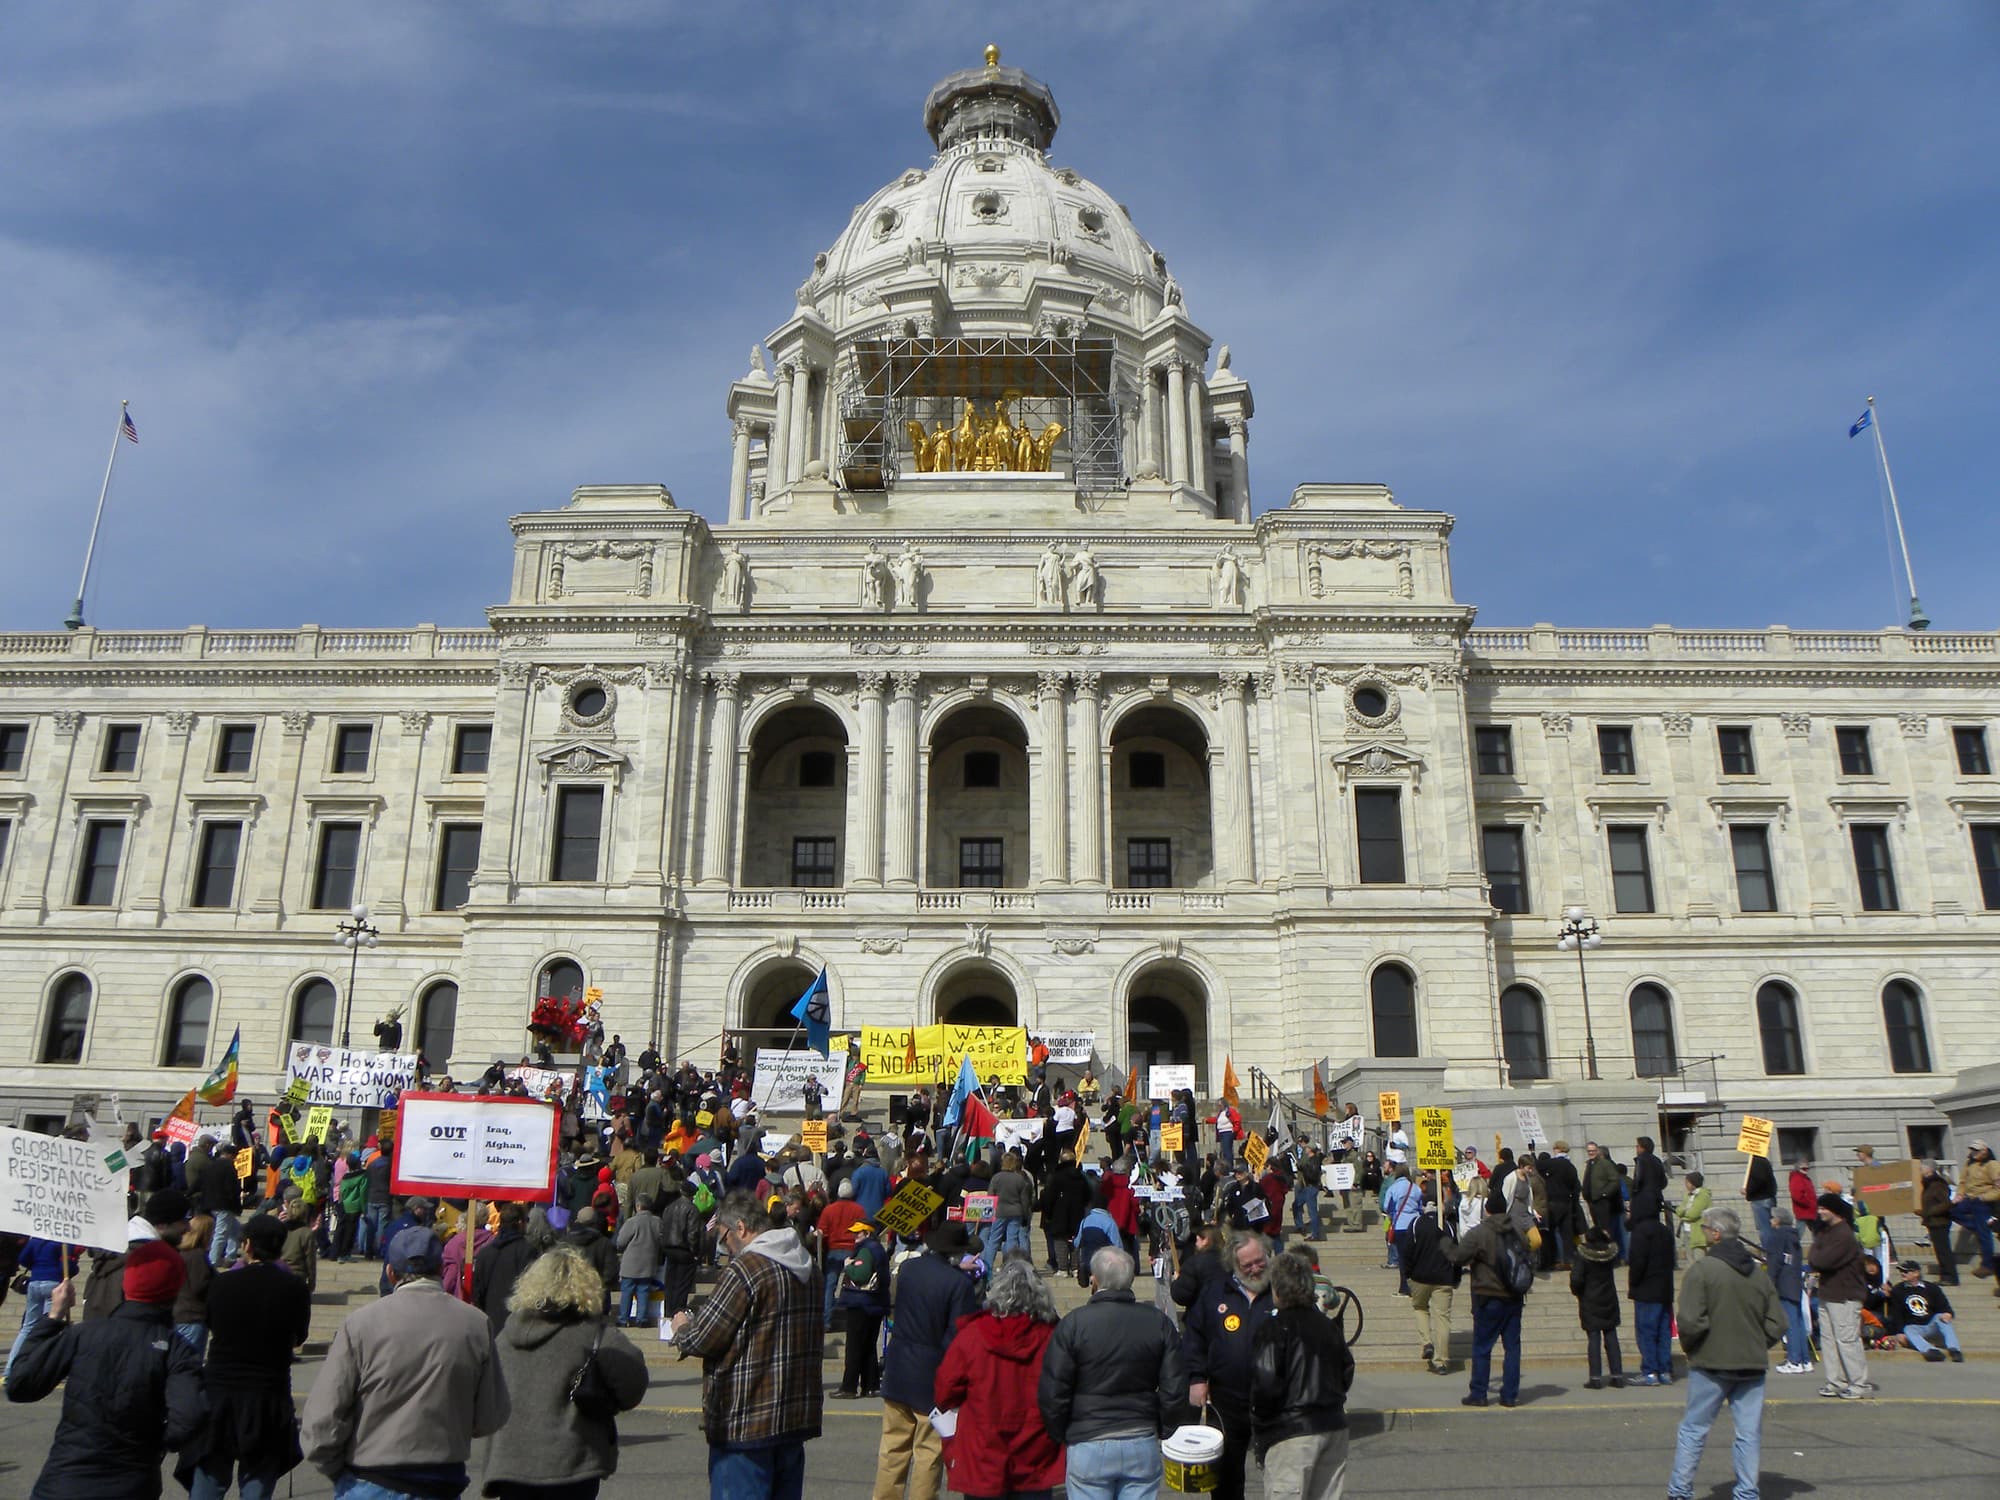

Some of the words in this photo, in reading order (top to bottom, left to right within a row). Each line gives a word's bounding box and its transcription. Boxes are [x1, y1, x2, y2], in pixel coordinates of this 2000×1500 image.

[870, 1032, 910, 1048] HAD
[954, 1027, 1009, 1040] W.A.R.
[948, 1040, 1015, 1055] Wasted
[1048, 1038, 1068, 1047] MORE
[340, 1052, 385, 1069] How's
[391, 1057, 415, 1070] the
[947, 1056, 1019, 1069] Aerican
[292, 1065, 334, 1083] WAR
[339, 1070, 414, 1090] ECONOMY
[308, 1086, 342, 1105] rking
[349, 1087, 371, 1104] for
[1384, 1108, 1396, 1116] NOT
[1426, 1110, 1440, 1118] U.S.
[310, 1115, 328, 1125] WAR
[1421, 1119, 1447, 1128] HANDS
[309, 1126, 324, 1136] NOT
[430, 1126, 467, 1139] OUT
[487, 1126, 512, 1135] Iraq,
[1428, 1128, 1442, 1136] OFF
[485, 1141, 526, 1150] Afghan,
[1429, 1140, 1443, 1149] THE
[12, 1136, 96, 1169] GLOBALIZE
[486, 1156, 515, 1164] Libya
[24, 1184, 46, 1199] TO
[51, 1187, 91, 1209] WAR
[913, 1187, 931, 1203] U.S.
[896, 1191, 931, 1216] HANDS
[12, 1199, 96, 1224] IGNORANCE
[893, 1205, 916, 1220] OFF
[33, 1218, 81, 1239] GREED
[879, 1210, 912, 1234] LIBYA!
